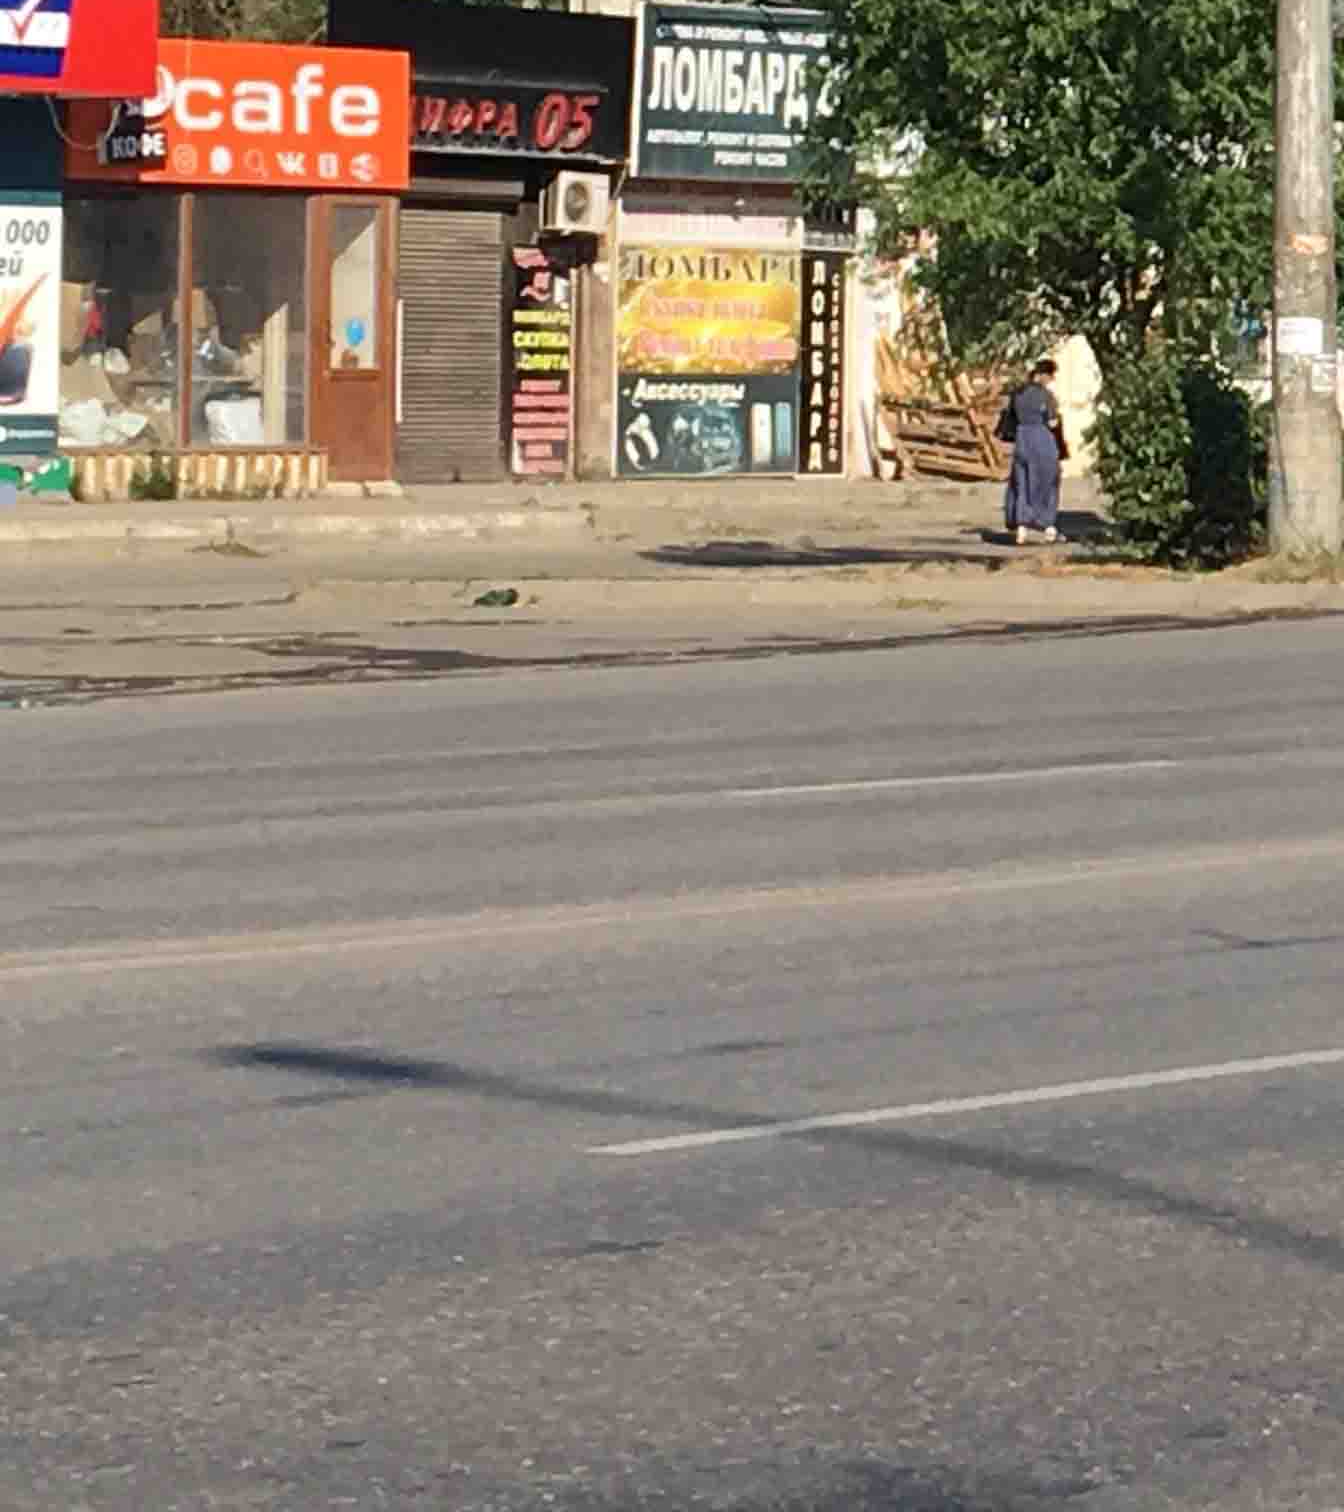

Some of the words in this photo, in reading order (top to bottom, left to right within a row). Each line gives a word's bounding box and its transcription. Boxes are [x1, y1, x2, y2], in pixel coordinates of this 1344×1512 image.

[173, 63, 381, 138] cafe
[647, 45, 809, 130] ЛОМБАРД
[410, 96, 519, 137] ИФРА
[535, 94, 600, 152] 05
[631, 378, 746, 408] Аксессуары
